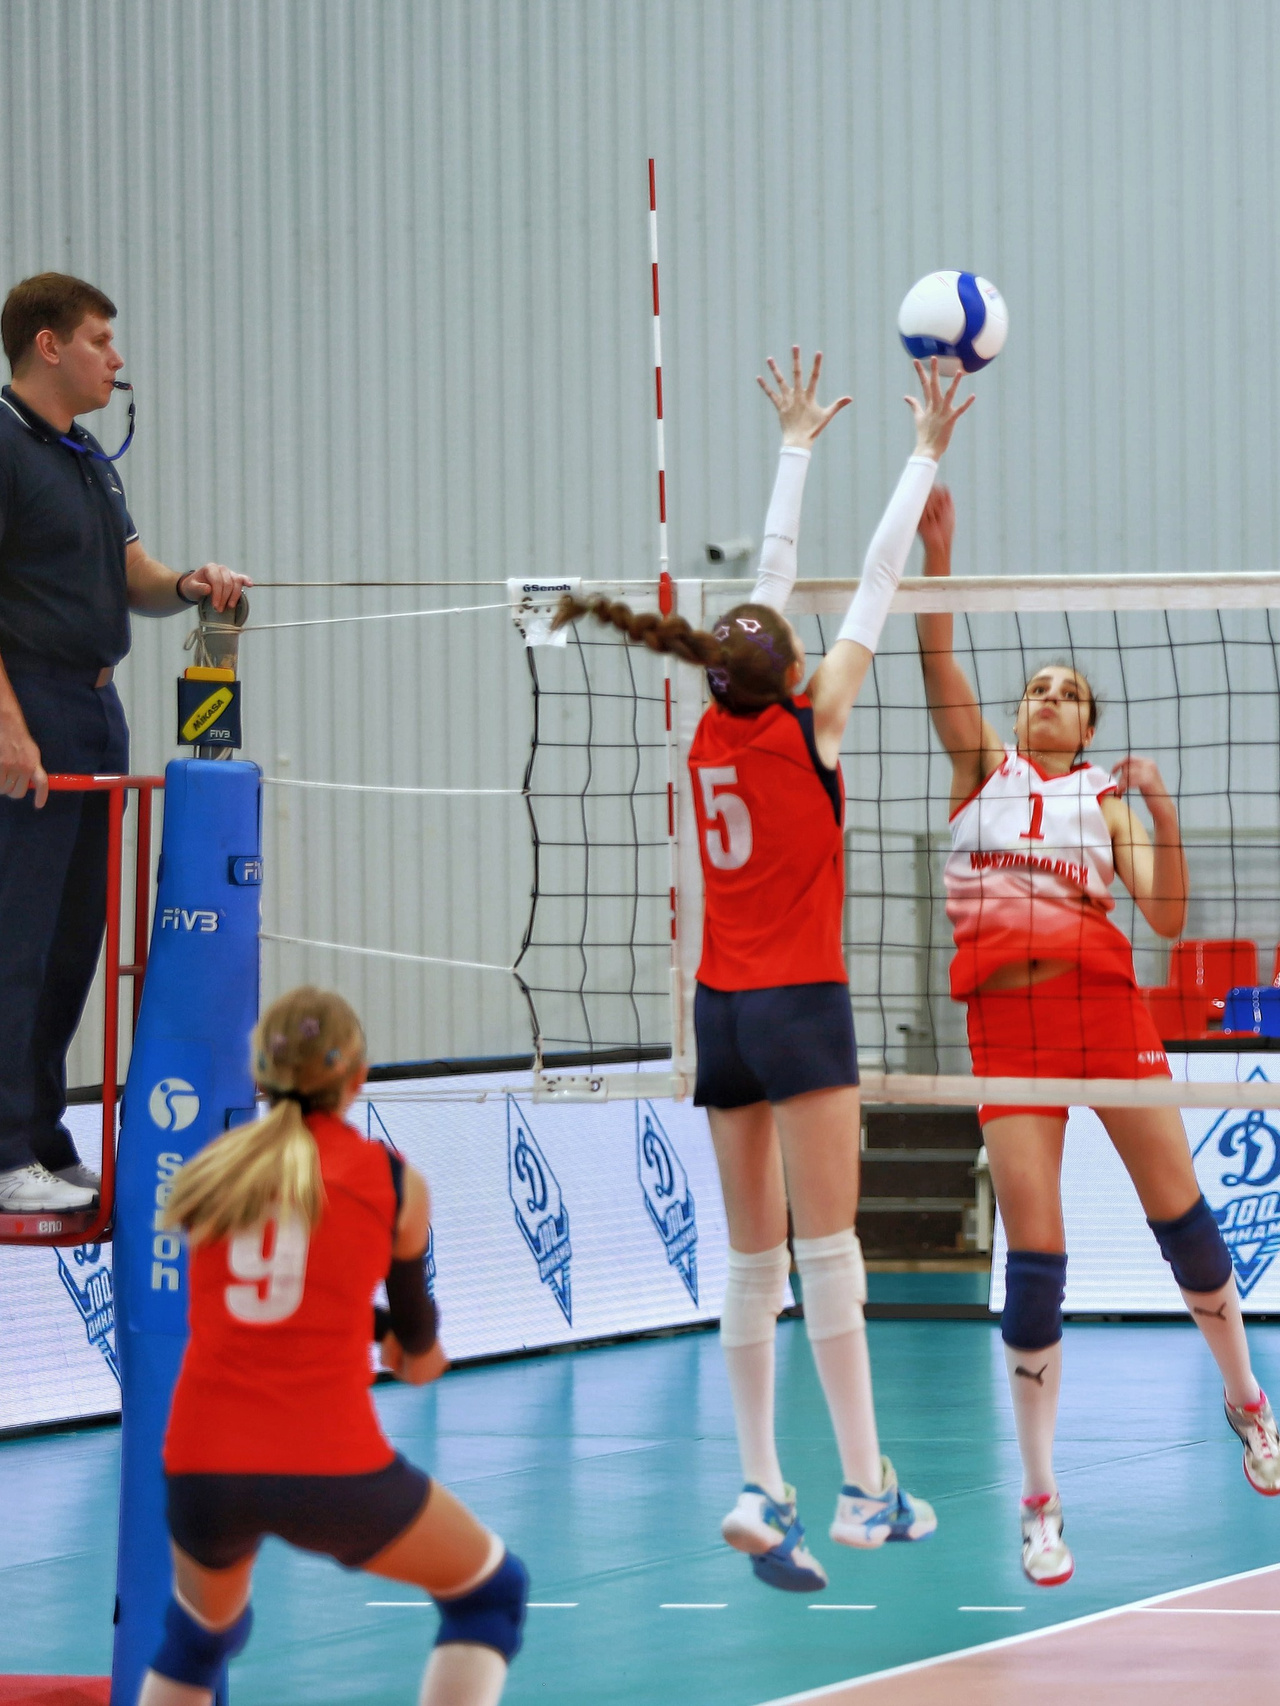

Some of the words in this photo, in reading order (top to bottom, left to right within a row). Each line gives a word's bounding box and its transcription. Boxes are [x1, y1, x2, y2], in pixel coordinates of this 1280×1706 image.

[531, 584, 571, 592] Senoh
[698, 765, 753, 870] 5
[1019, 793, 1044, 839] 1
[1224, 1192, 1279, 1229] 100
[224, 1208, 310, 1325] 9
